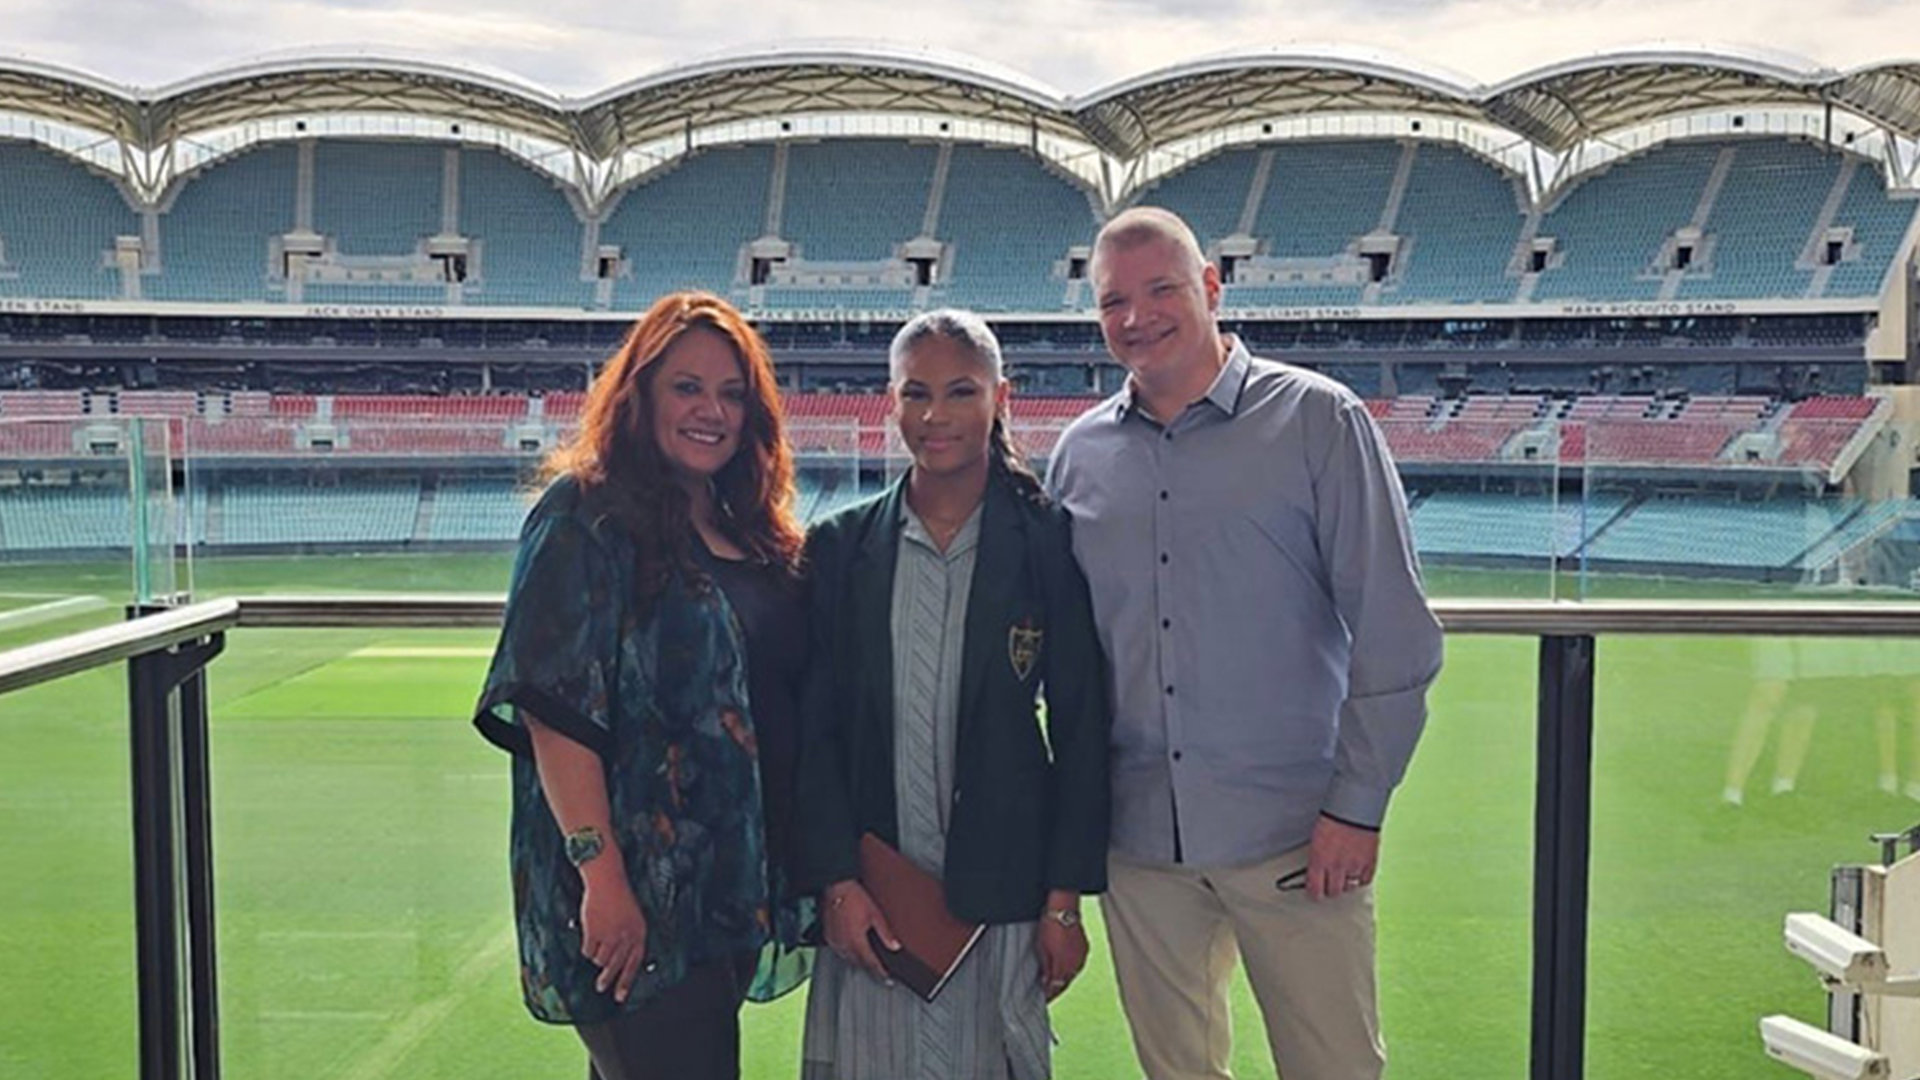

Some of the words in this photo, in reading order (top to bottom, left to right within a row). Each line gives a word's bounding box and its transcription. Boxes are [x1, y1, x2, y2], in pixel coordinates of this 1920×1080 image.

[34, 301, 84, 310] STAND
[307, 306, 340, 316] JACK
[398, 306, 444, 316] STAND
[1562, 304, 1602, 313] MARK
[1686, 301, 1736, 312] STAND
[753, 309, 784, 320] MAX
[868, 309, 916, 320] STAND
[1245, 308, 1310, 318] WILLIAMS
[1316, 307, 1361, 318] STAND
